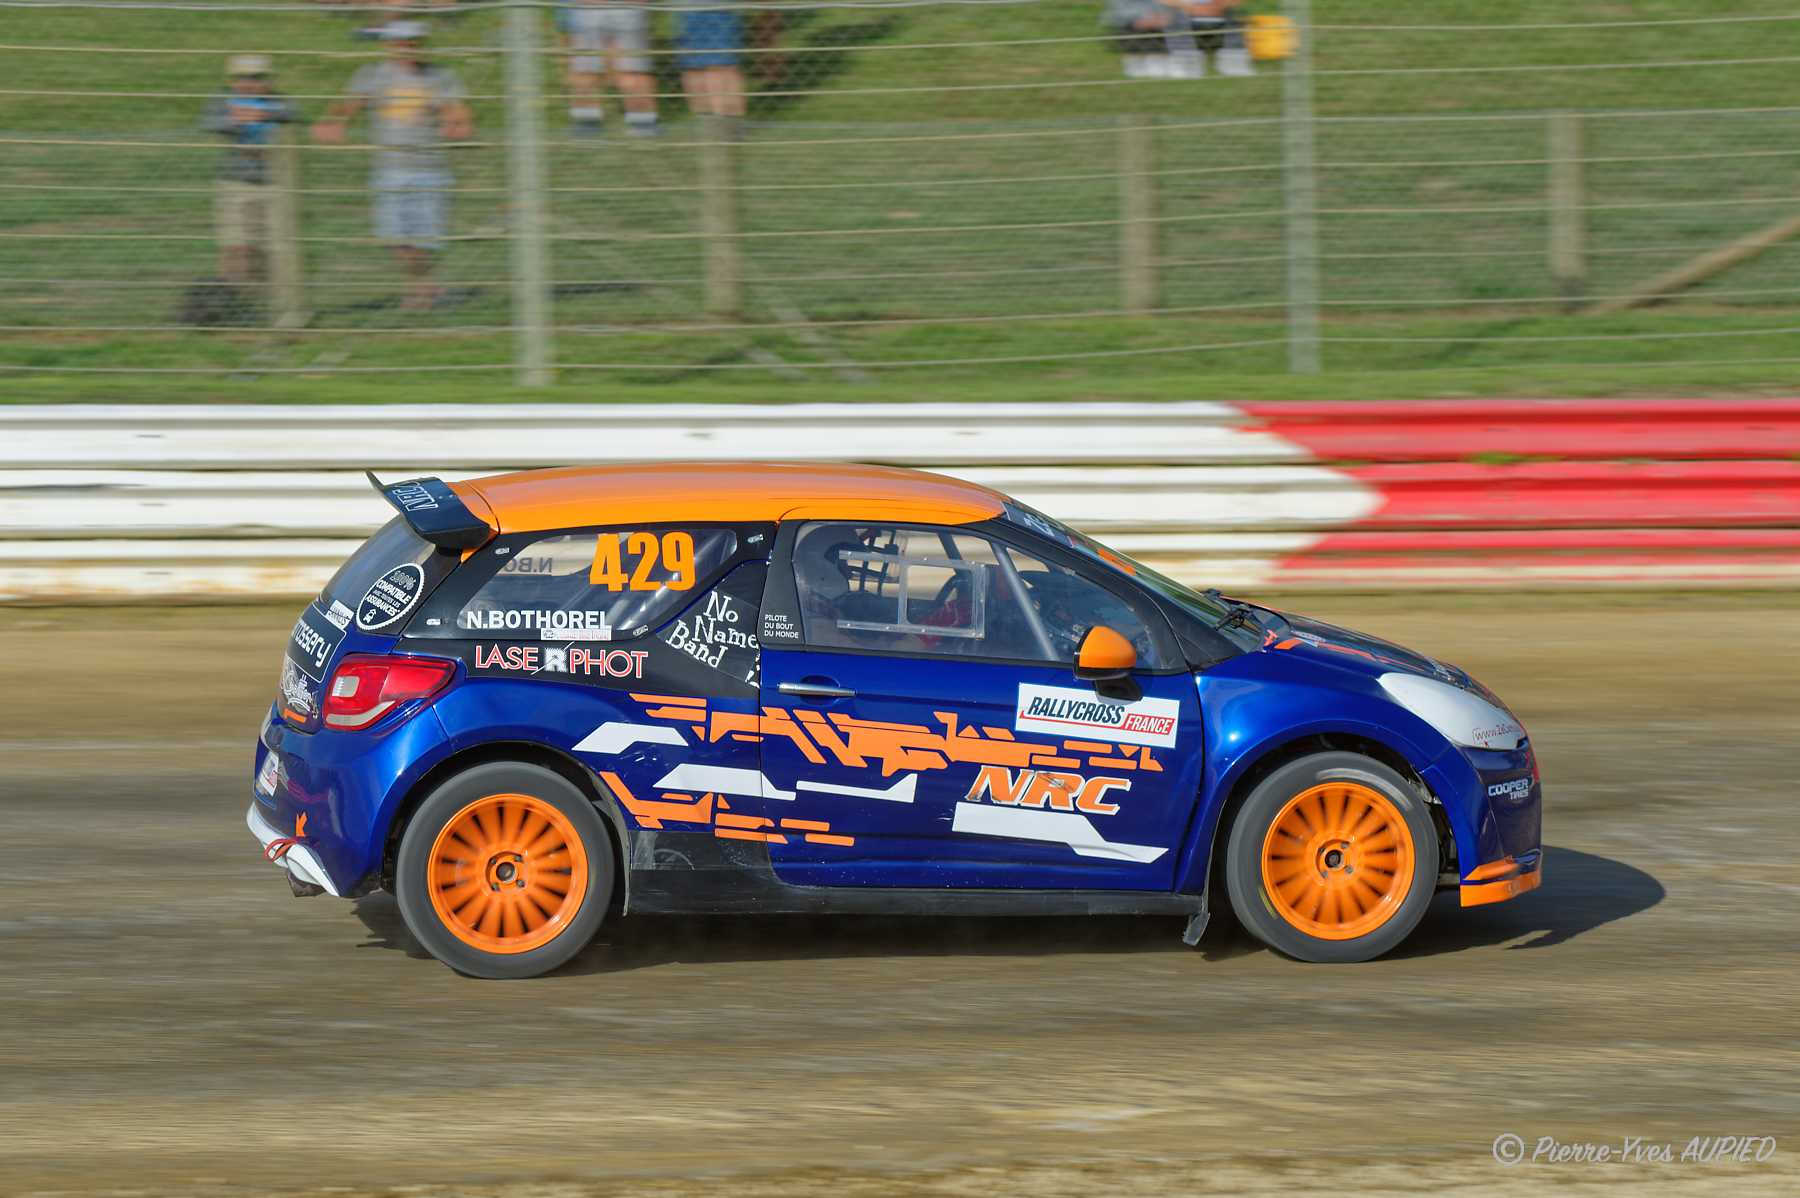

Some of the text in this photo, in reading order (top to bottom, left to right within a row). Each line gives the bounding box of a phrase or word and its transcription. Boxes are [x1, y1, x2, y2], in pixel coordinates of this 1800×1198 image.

[589, 532, 695, 591] 429
[376, 579, 412, 605] COMPATIBLE
[704, 591, 739, 623] No
[764, 614, 788, 622] PILOTE
[467, 611, 611, 630] N.BOTHOREL
[692, 615, 759, 649] Name
[764, 622, 774, 630] DU
[665, 619, 728, 668] Band
[775, 631, 799, 639] MONDE
[1027, 696, 1126, 725] RALLYCROSS
[1124, 715, 1173, 736] FRANCE
[965, 765, 1131, 816] NRC
[1488, 778, 1529, 796] COOPER
